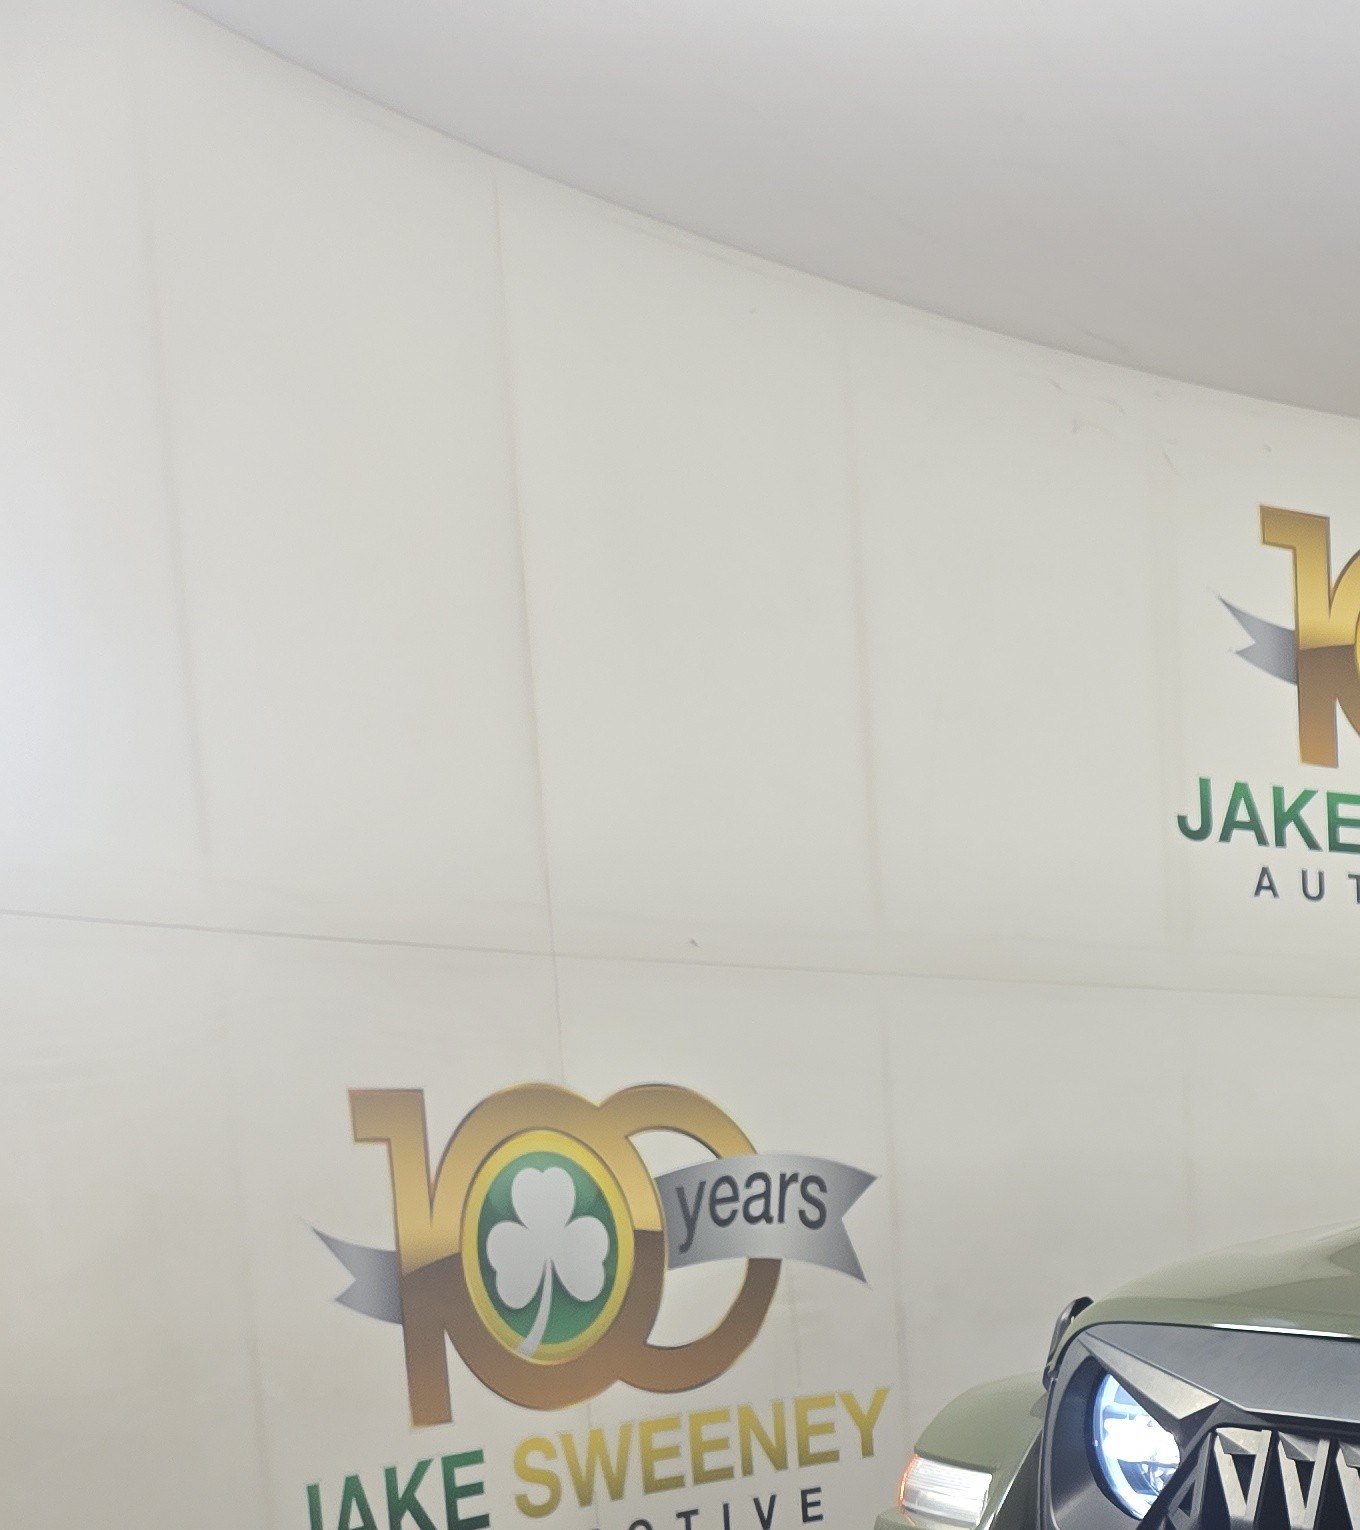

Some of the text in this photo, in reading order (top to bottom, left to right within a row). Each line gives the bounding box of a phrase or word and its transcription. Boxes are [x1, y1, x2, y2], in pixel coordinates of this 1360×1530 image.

[347, 1082, 828, 1428] 100 years
[513, 1386, 890, 1519] SWEENEY
